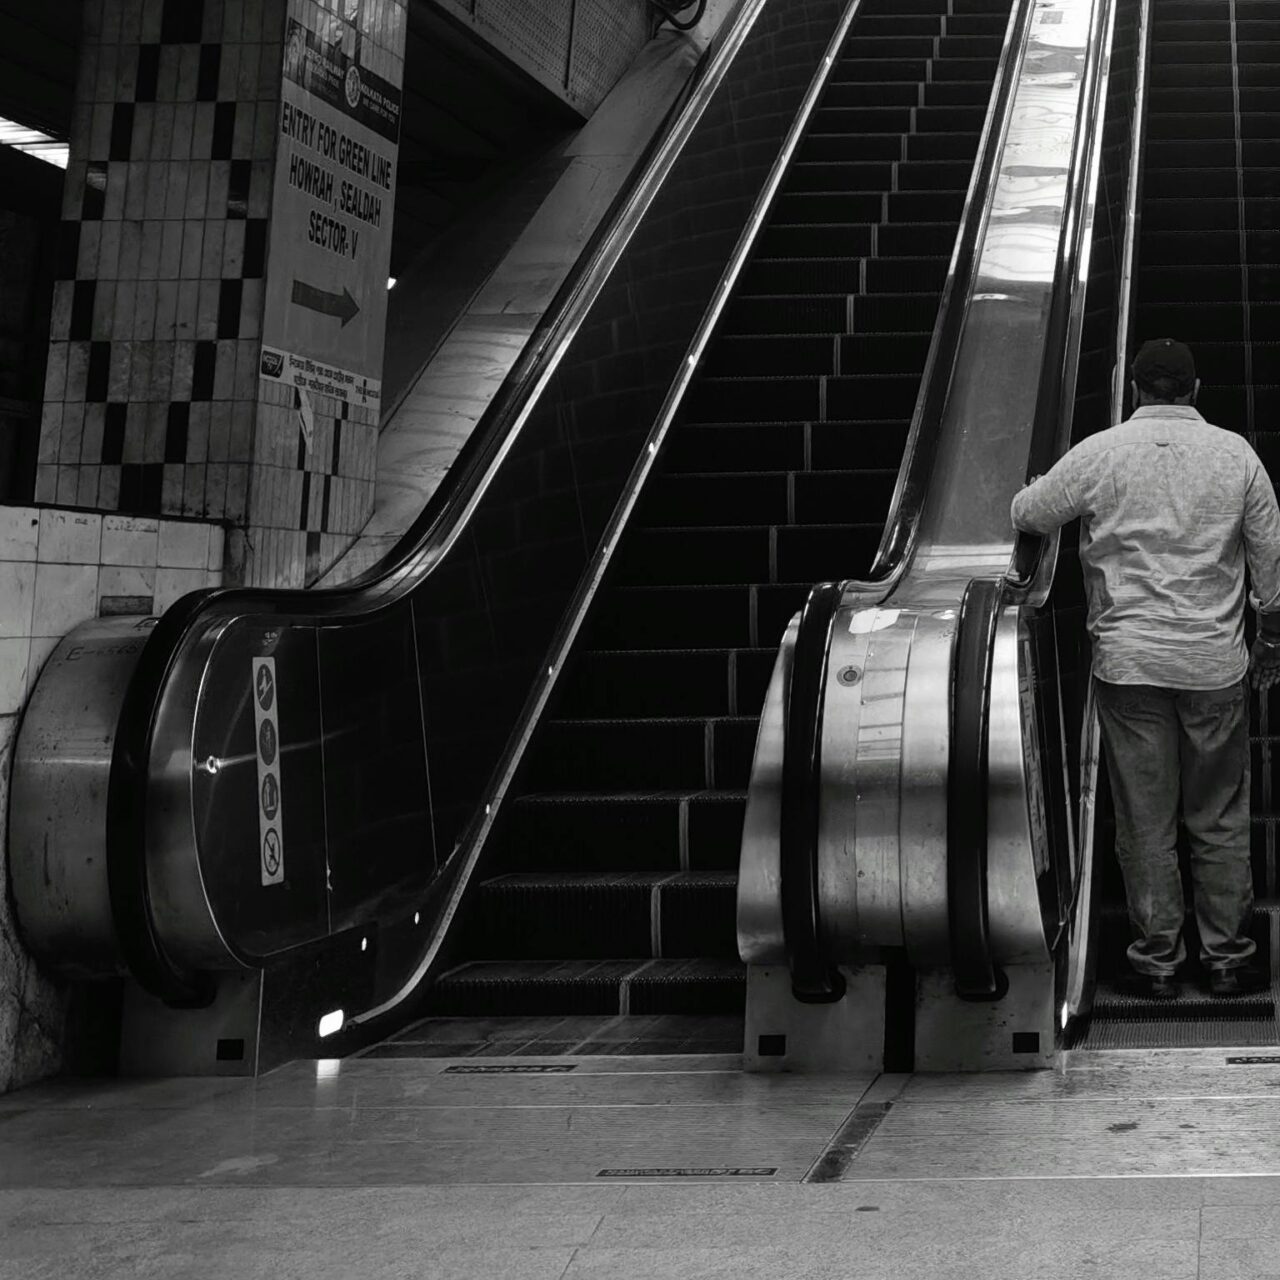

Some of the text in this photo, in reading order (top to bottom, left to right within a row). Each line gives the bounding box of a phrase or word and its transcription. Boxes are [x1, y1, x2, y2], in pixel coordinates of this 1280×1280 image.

[360, 81, 383, 104] KOLKATA
[382, 97, 400, 116] POLICE
[281, 101, 392, 190] ENTRY FOR GREEN LINE
[340, 180, 382, 228] SEALDAH
[309, 209, 359, 260] SECTOR- V
